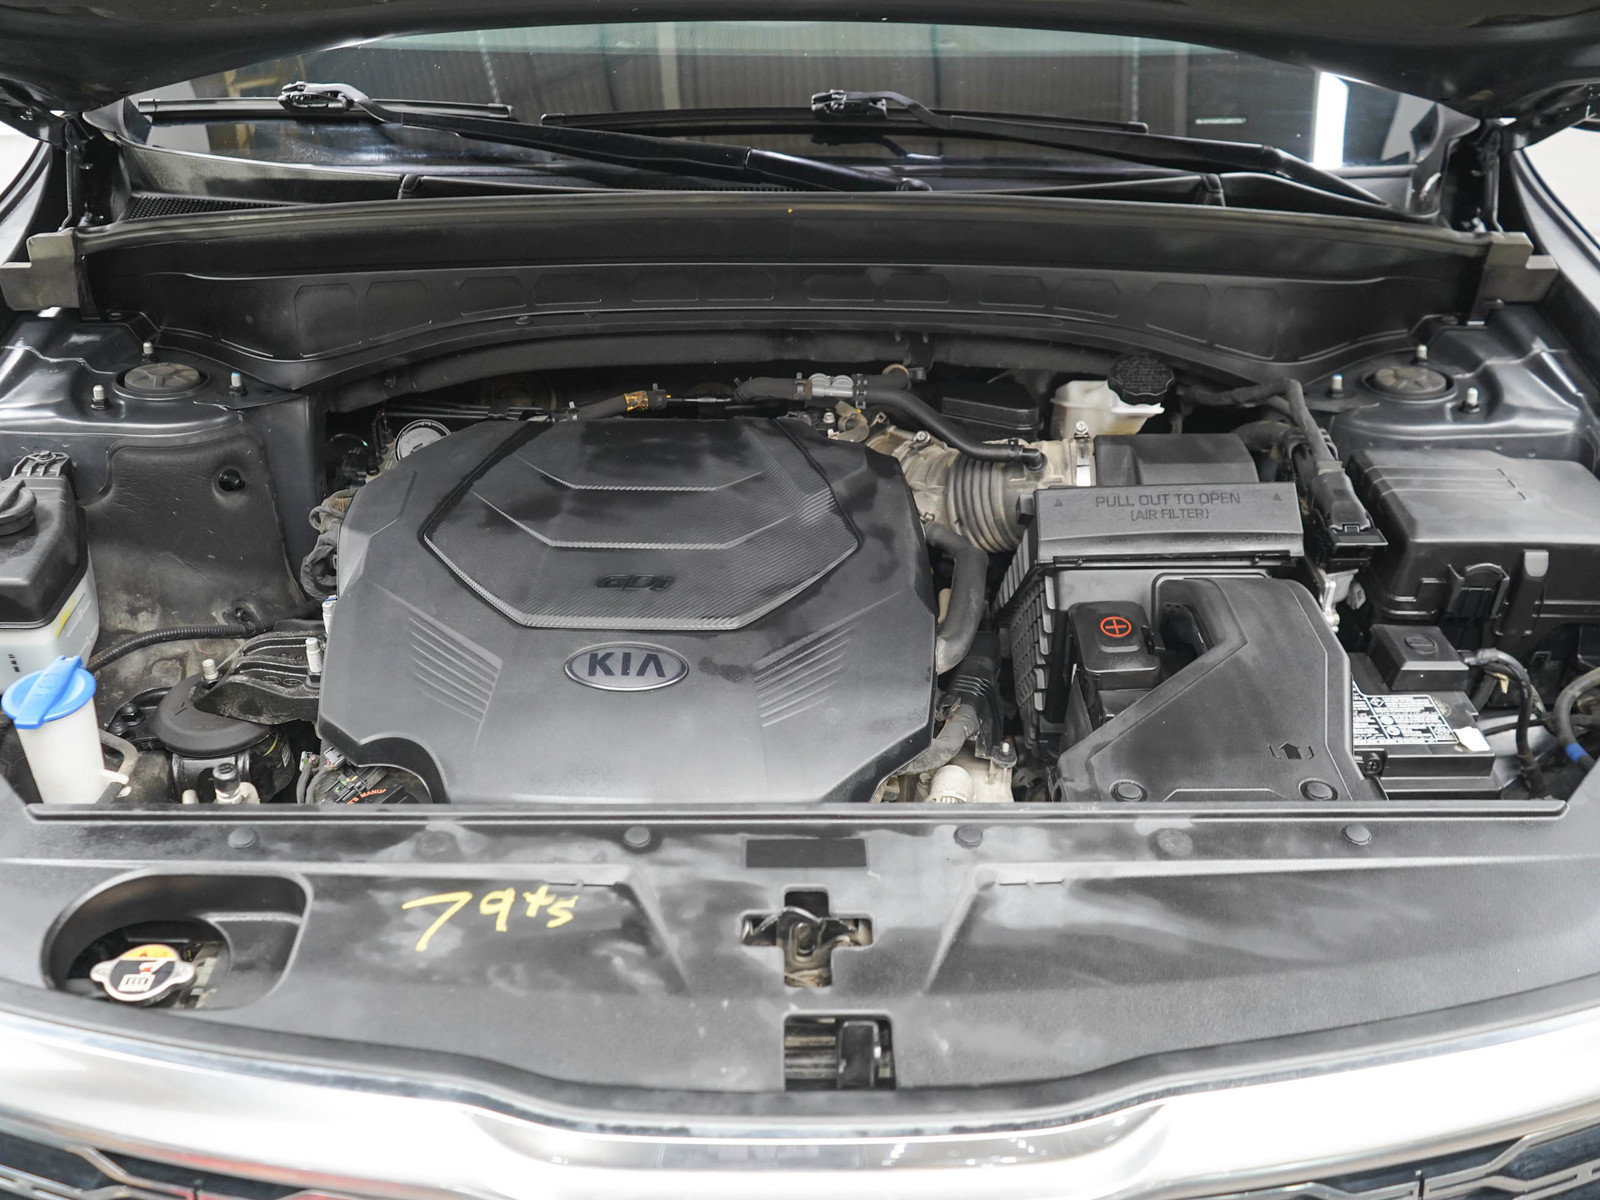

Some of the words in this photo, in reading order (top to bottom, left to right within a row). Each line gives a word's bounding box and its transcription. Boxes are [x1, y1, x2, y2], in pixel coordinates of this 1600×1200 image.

[1095, 495, 1135, 507] PULL
[1139, 494, 1169, 506] OUT
[1174, 493, 1195, 505] TO
[1199, 492, 1241, 505] OPEN
[1161, 508, 1210, 520] FILTER)
[588, 652, 666, 678] KIA
